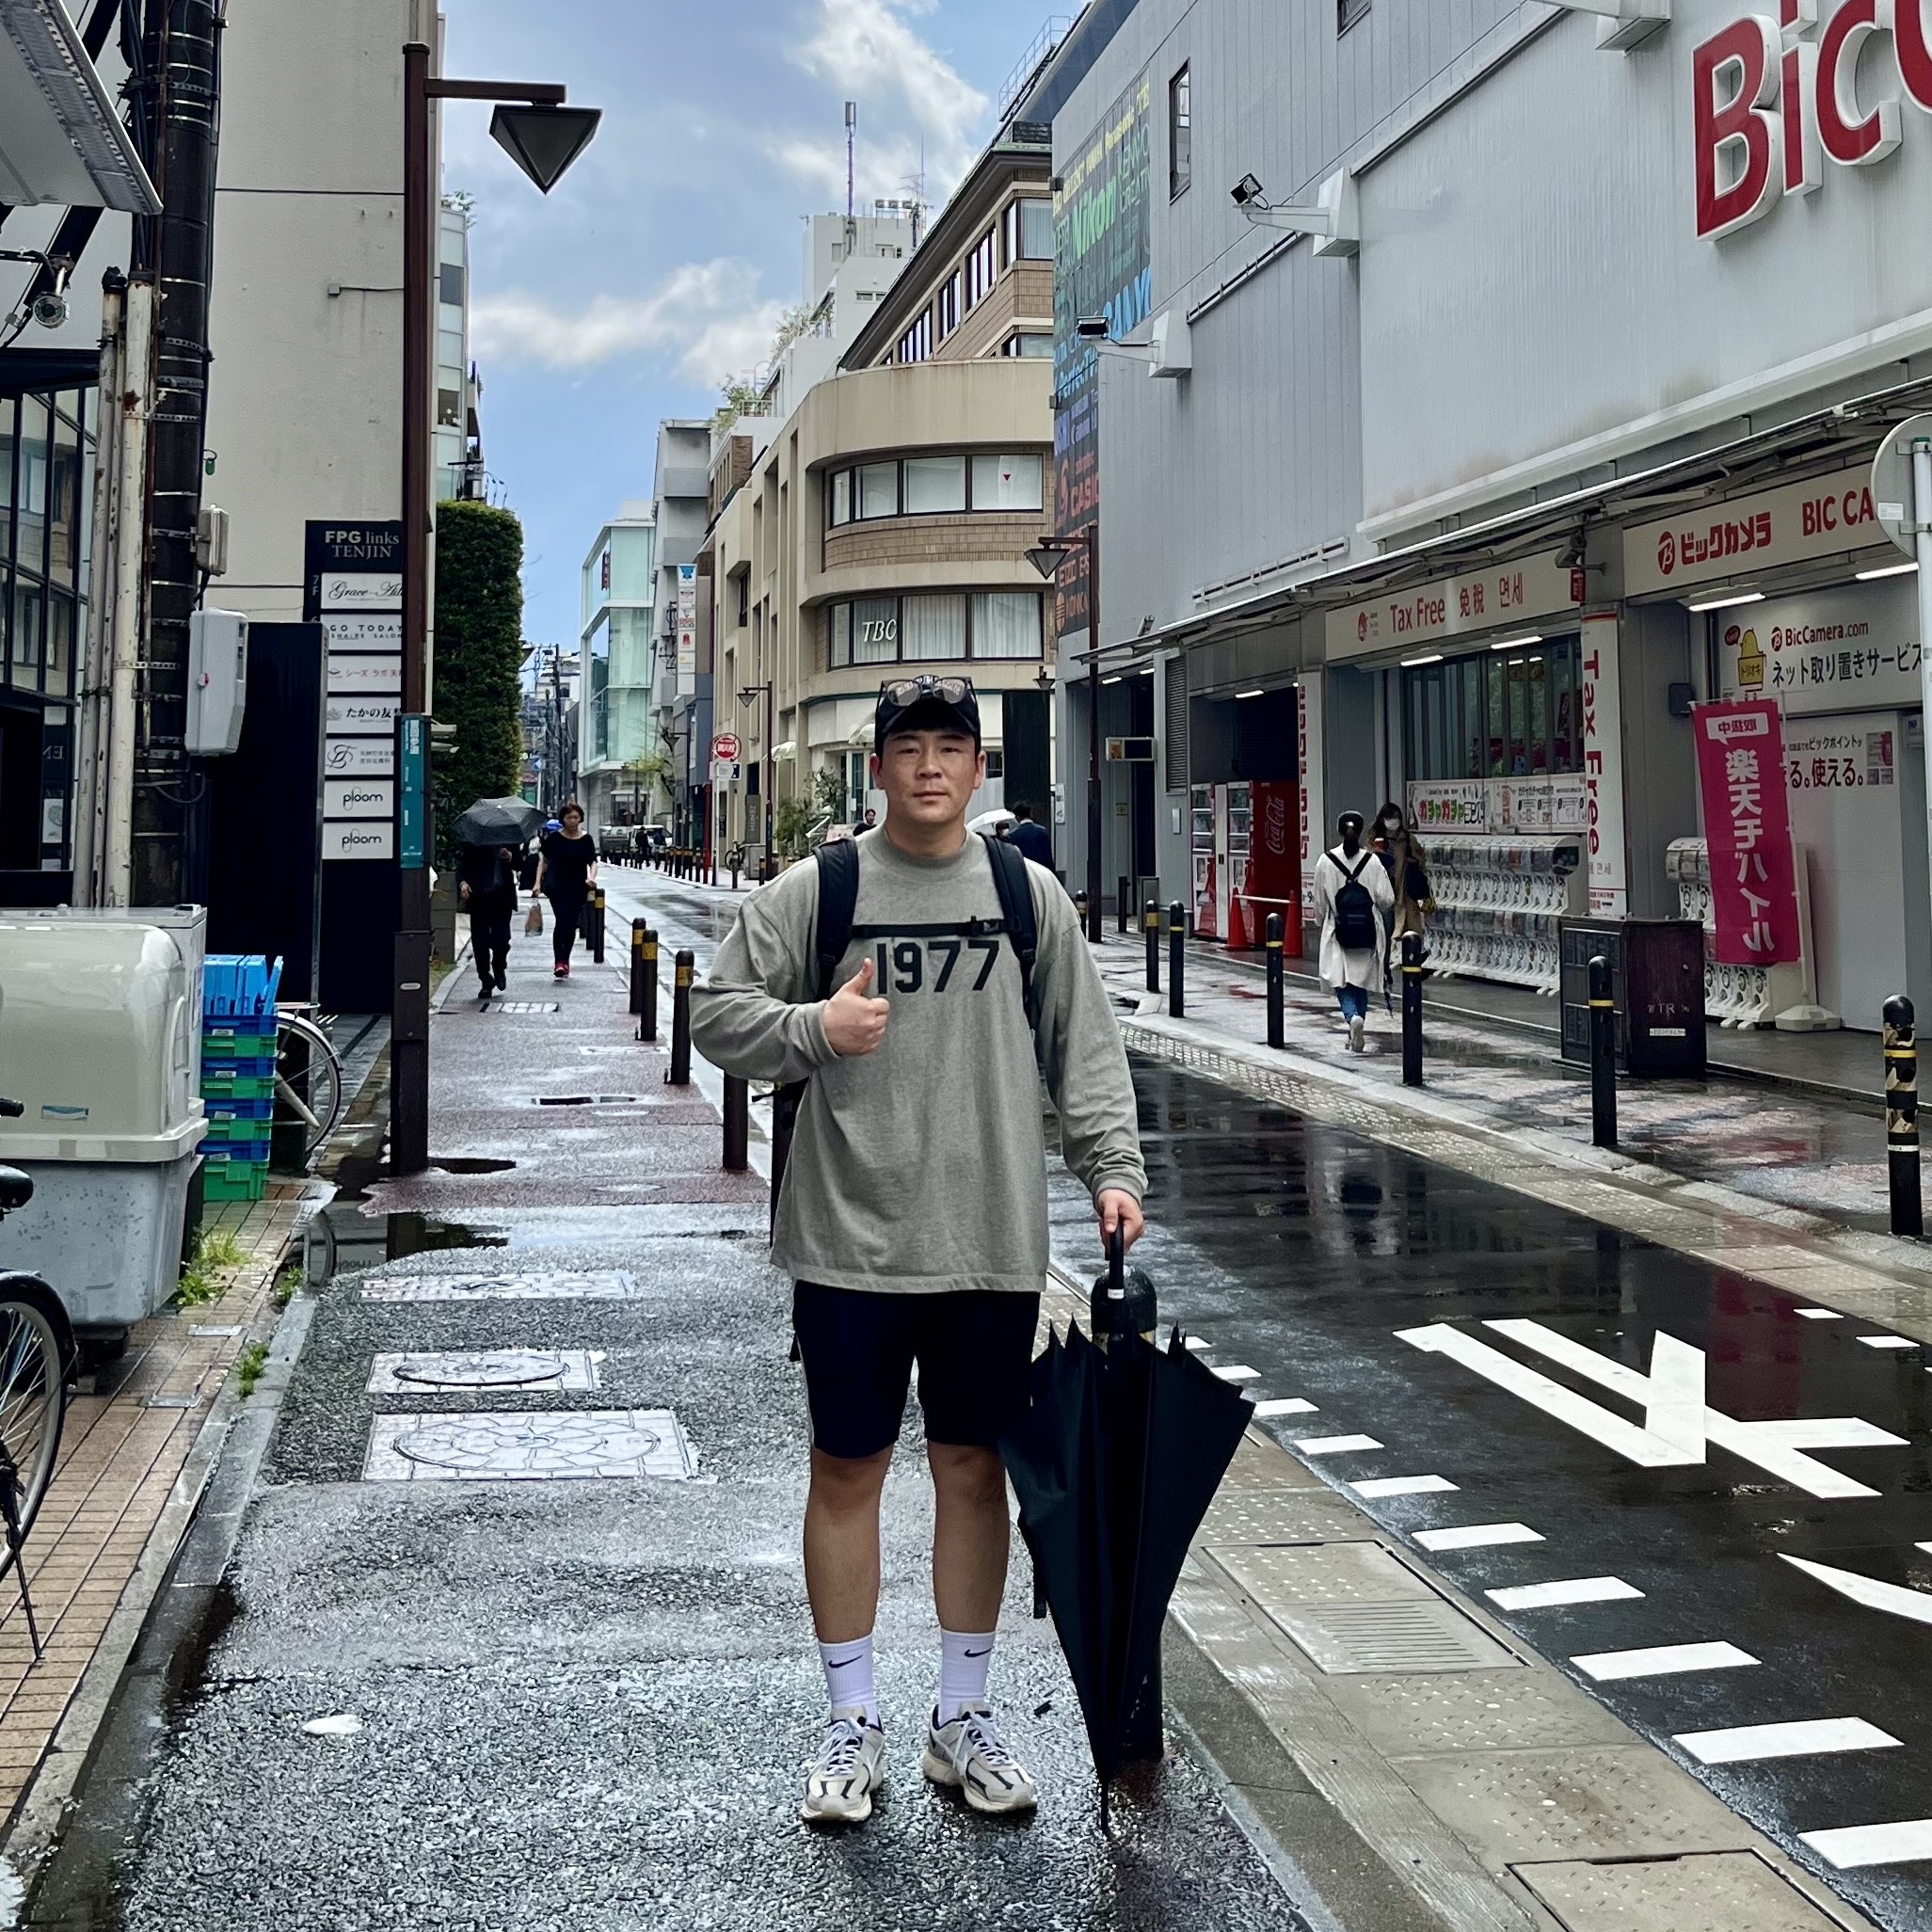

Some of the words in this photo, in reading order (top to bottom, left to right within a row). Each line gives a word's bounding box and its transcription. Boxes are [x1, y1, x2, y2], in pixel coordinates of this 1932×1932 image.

[1692, 0, 1932, 241] Bic
[1072, 176, 1117, 261] Nikon
[1802, 496, 1837, 536] BIC
[325, 531, 361, 544] FPG
[365, 531, 399, 545] links
[332, 545, 392, 559] TENJIN
[1681, 512, 1771, 566] ビックカメラ
[1499, 572, 1524, 608] 면세
[862, 618, 898, 643] TBC
[1390, 604, 1413, 634] Tax
[1416, 598, 1445, 628] Free
[1785, 622, 1869, 647] BicCamera.com
[1772, 642, 1922, 688] ネット取り置きサービス
[1584, 649, 1600, 738] Tax
[343, 787, 383, 810] ploom
[1586, 751, 1602, 855] Free
[342, 829, 382, 853] ploom
[877, 939, 999, 995] 1977
